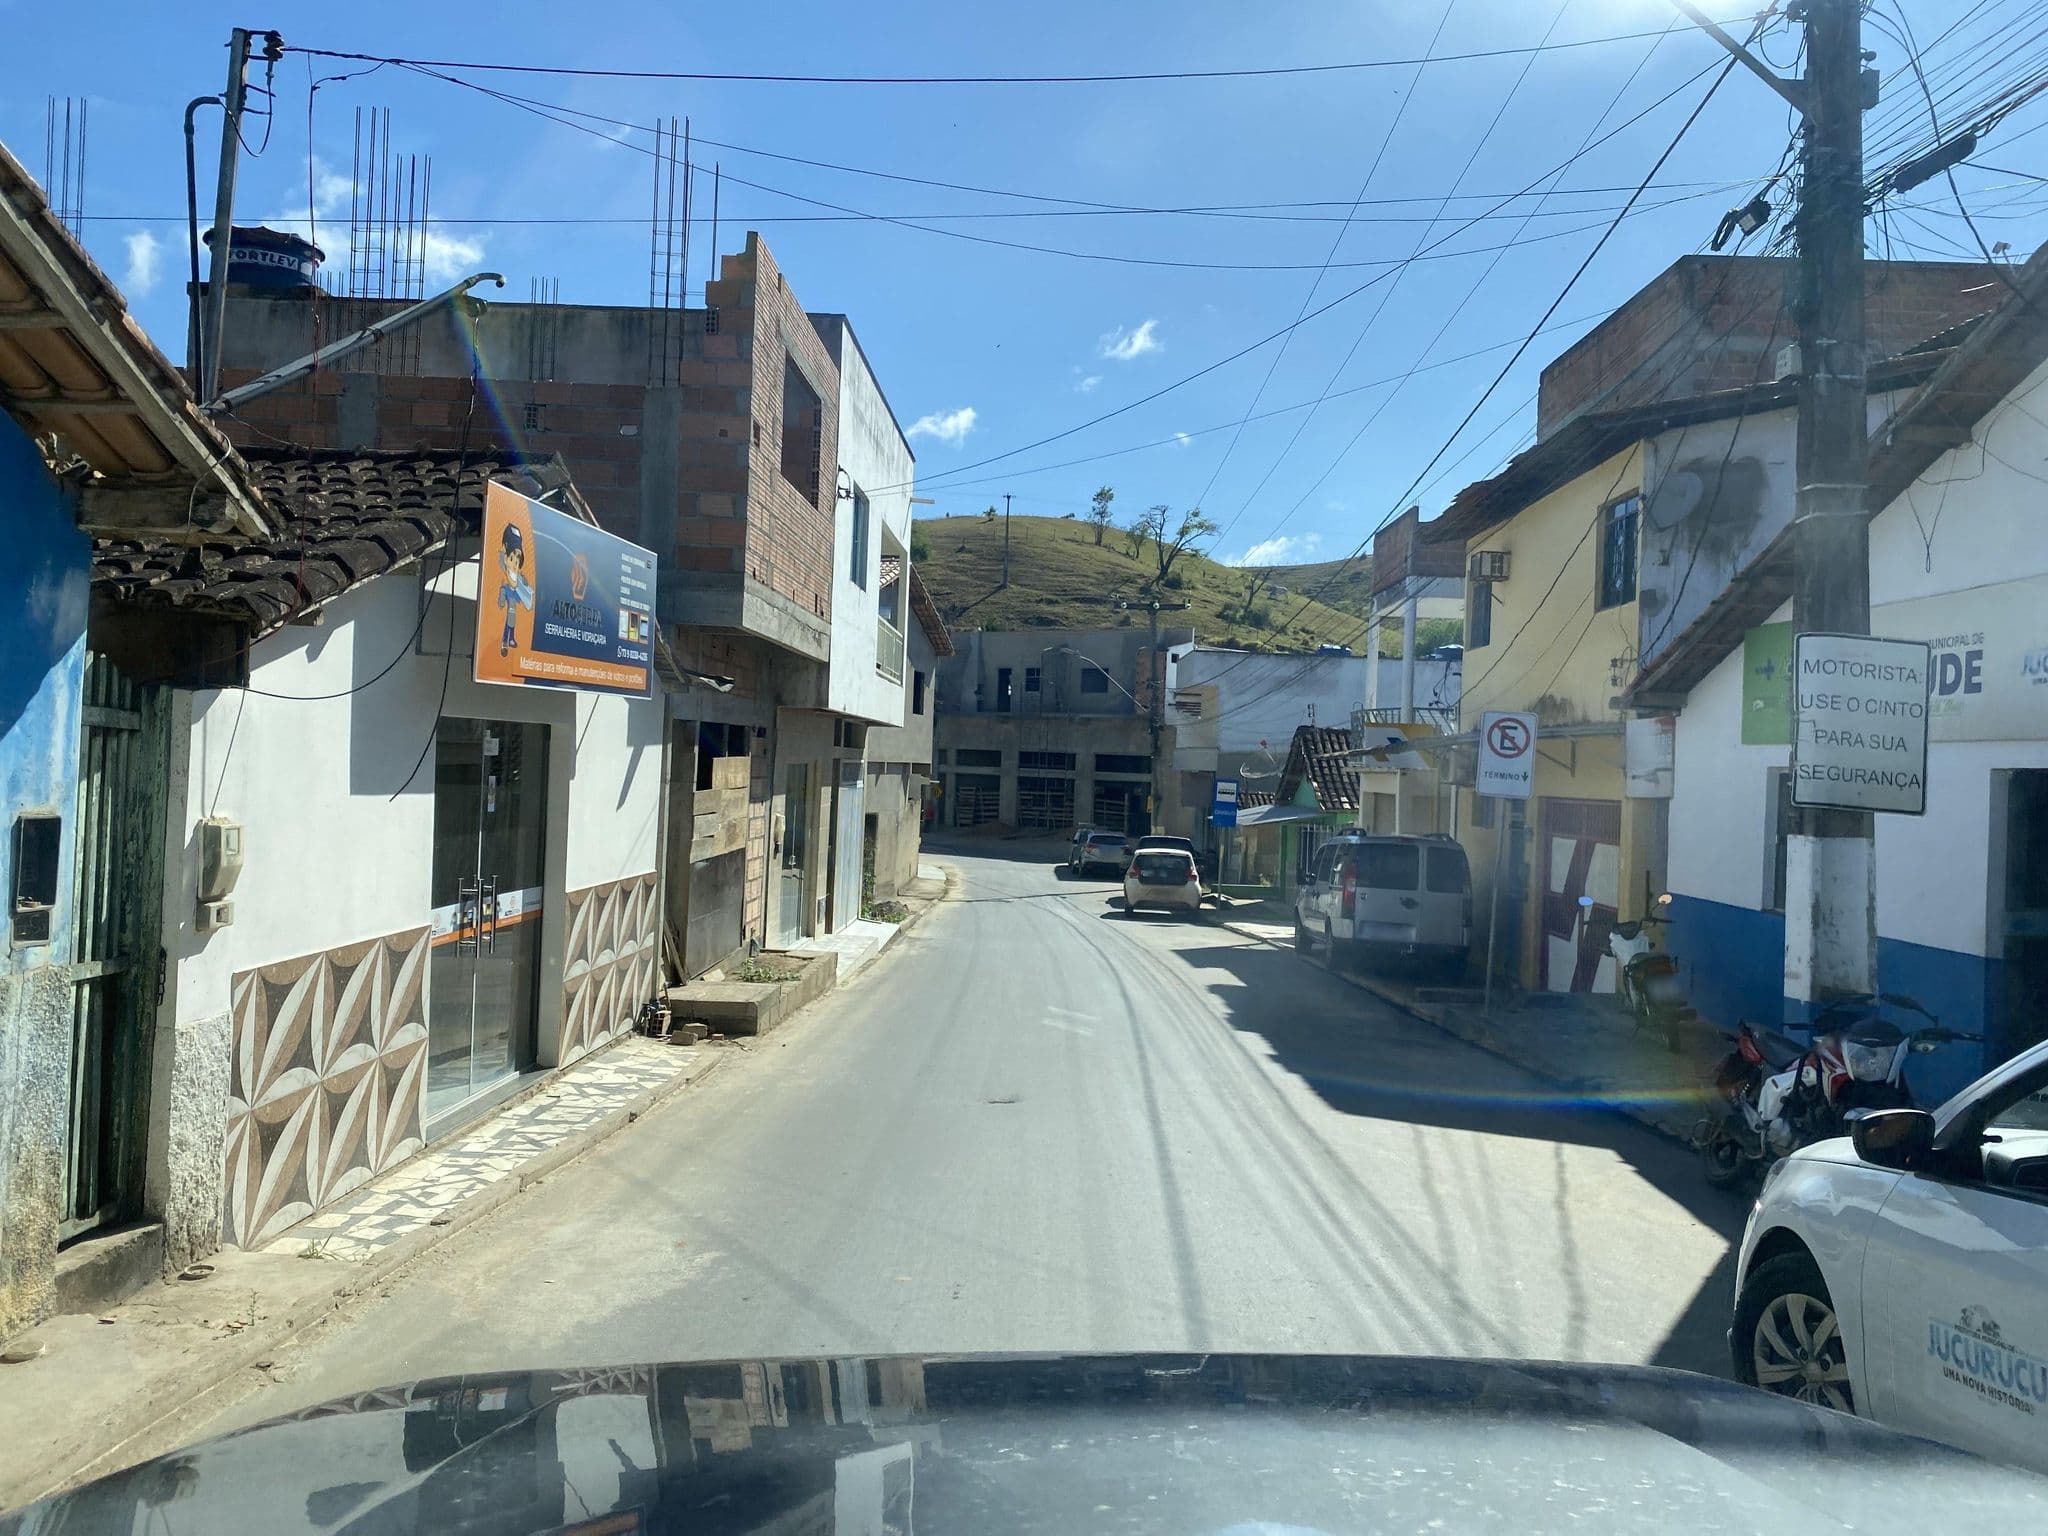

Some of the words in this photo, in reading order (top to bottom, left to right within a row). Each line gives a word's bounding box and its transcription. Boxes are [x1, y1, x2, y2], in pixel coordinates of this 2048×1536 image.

[1800, 693, 1842, 711] USE
[1846, 696, 1861, 713] O
[1865, 698, 1923, 719] CINTO
[1814, 728, 1865, 749] PARA
[1868, 733, 1908, 753] SUA
[1799, 763, 1921, 791] SEGURANÇA
[1943, 1367, 1961, 1384] UMA
[1962, 1374, 1986, 1394] NOVA
